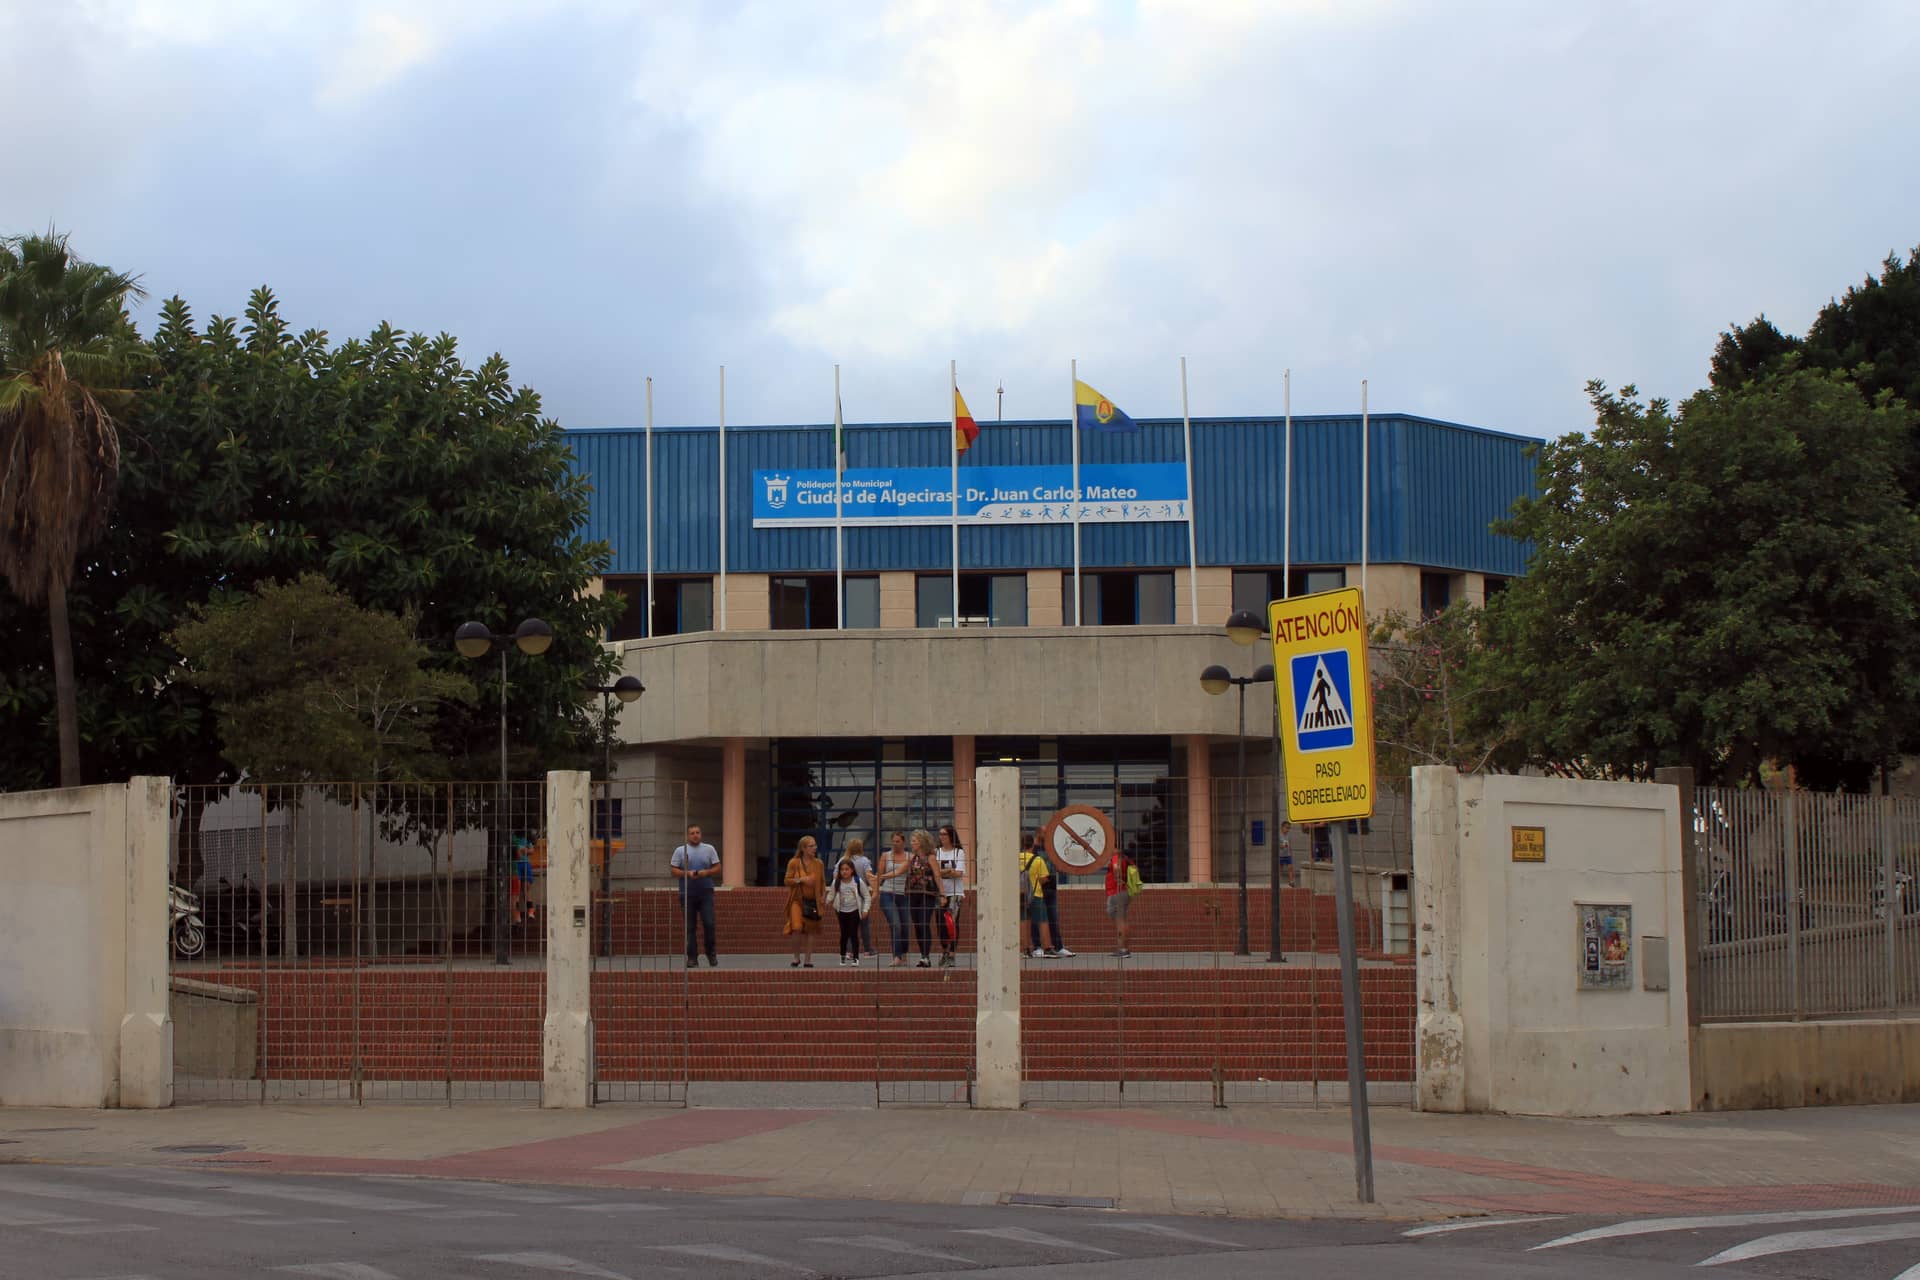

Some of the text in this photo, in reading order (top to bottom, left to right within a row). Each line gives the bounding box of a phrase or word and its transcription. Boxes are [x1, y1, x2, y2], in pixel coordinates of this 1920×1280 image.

[796, 479, 892, 489] Polideporvo Municipal
[856, 489, 877, 503] de
[880, 488, 953, 506] Algeciras
[966, 487, 991, 502] Dr.
[991, 487, 1028, 502] Juan
[1086, 486, 1137, 500] Mateo
[1275, 602, 1360, 644] ATENCIÓN
[1315, 761, 1341, 780] PASO
[1292, 783, 1367, 806] SOBREELEVADO
